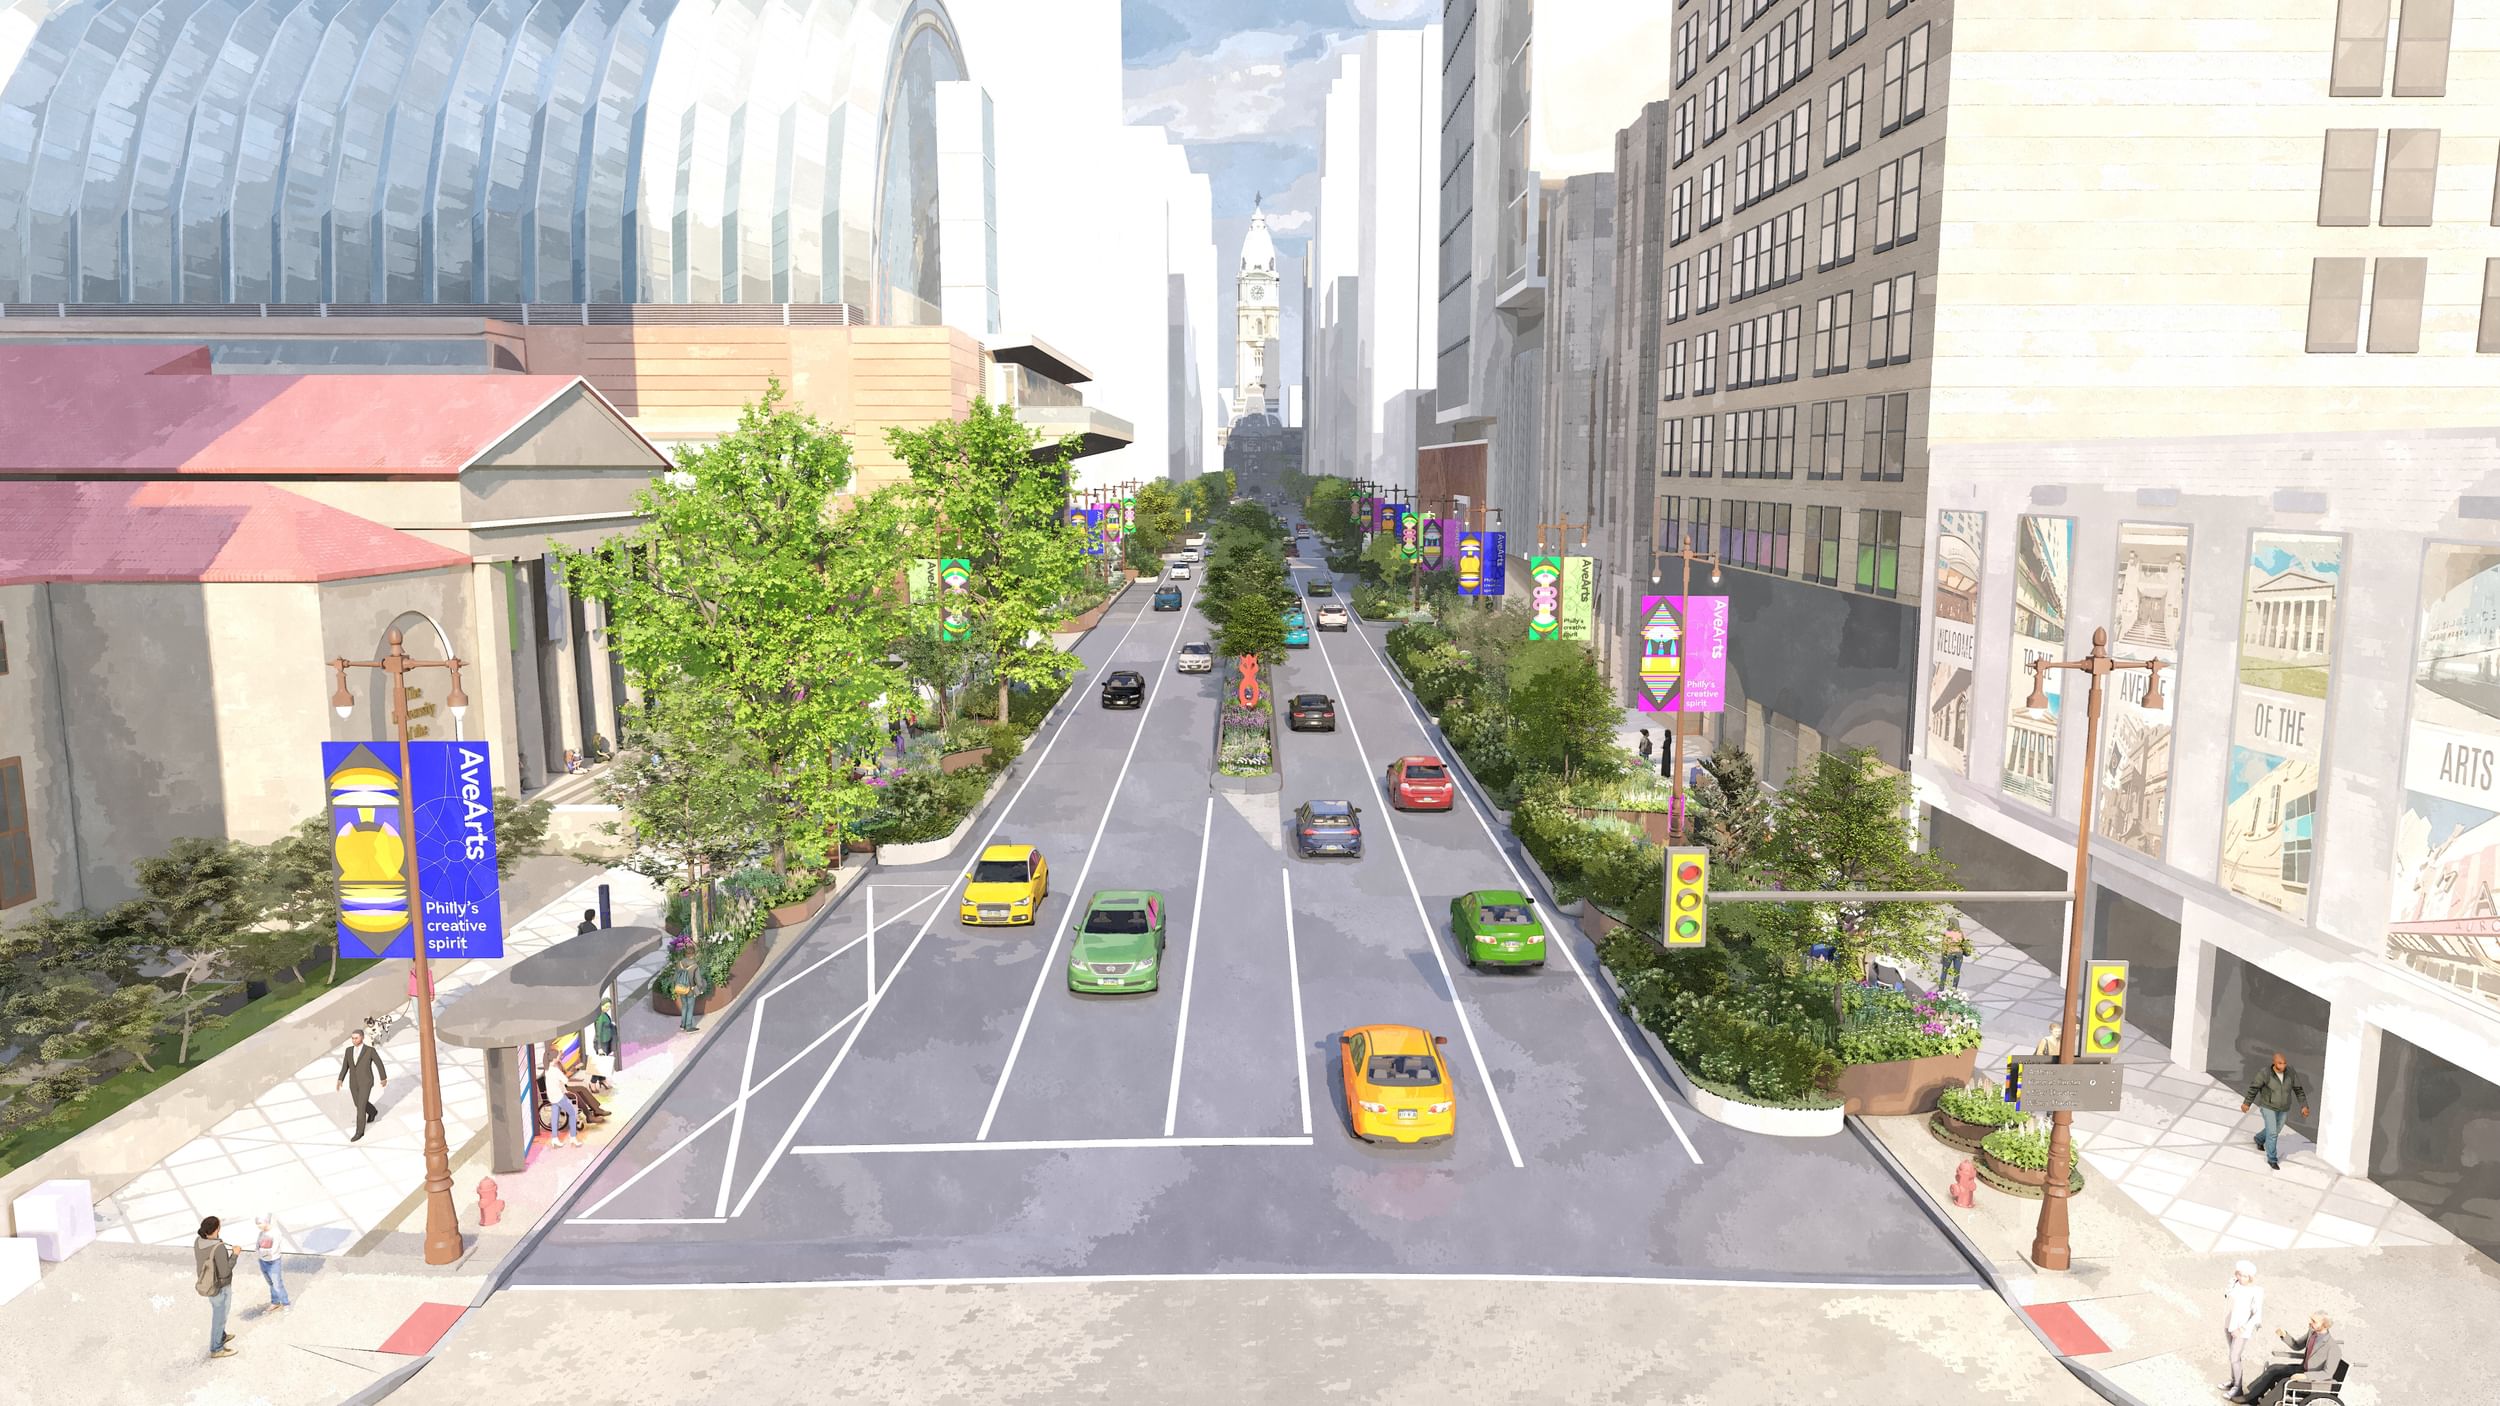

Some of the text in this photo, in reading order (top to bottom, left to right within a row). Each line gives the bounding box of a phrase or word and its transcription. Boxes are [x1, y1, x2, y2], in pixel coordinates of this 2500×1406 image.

[1497, 534, 1505, 567] AveArts
[1580, 559, 1591, 602] AveArts
[1712, 600, 1727, 659] AveArts
[1937, 628, 1973, 660] WELCOME
[2024, 648, 2034, 676] TO
[1687, 680, 1715, 690] Philly's
[1687, 690, 1718, 698] creative
[2120, 671, 2166, 704] AVENE
[1686, 699, 1707, 708] spirit
[2255, 703, 2306, 746] OF THE
[2439, 743, 2494, 791] ARTS
[458, 747, 489, 860] AveArts
[427, 919, 487, 932] creative
[428, 936, 468, 952] spirit
